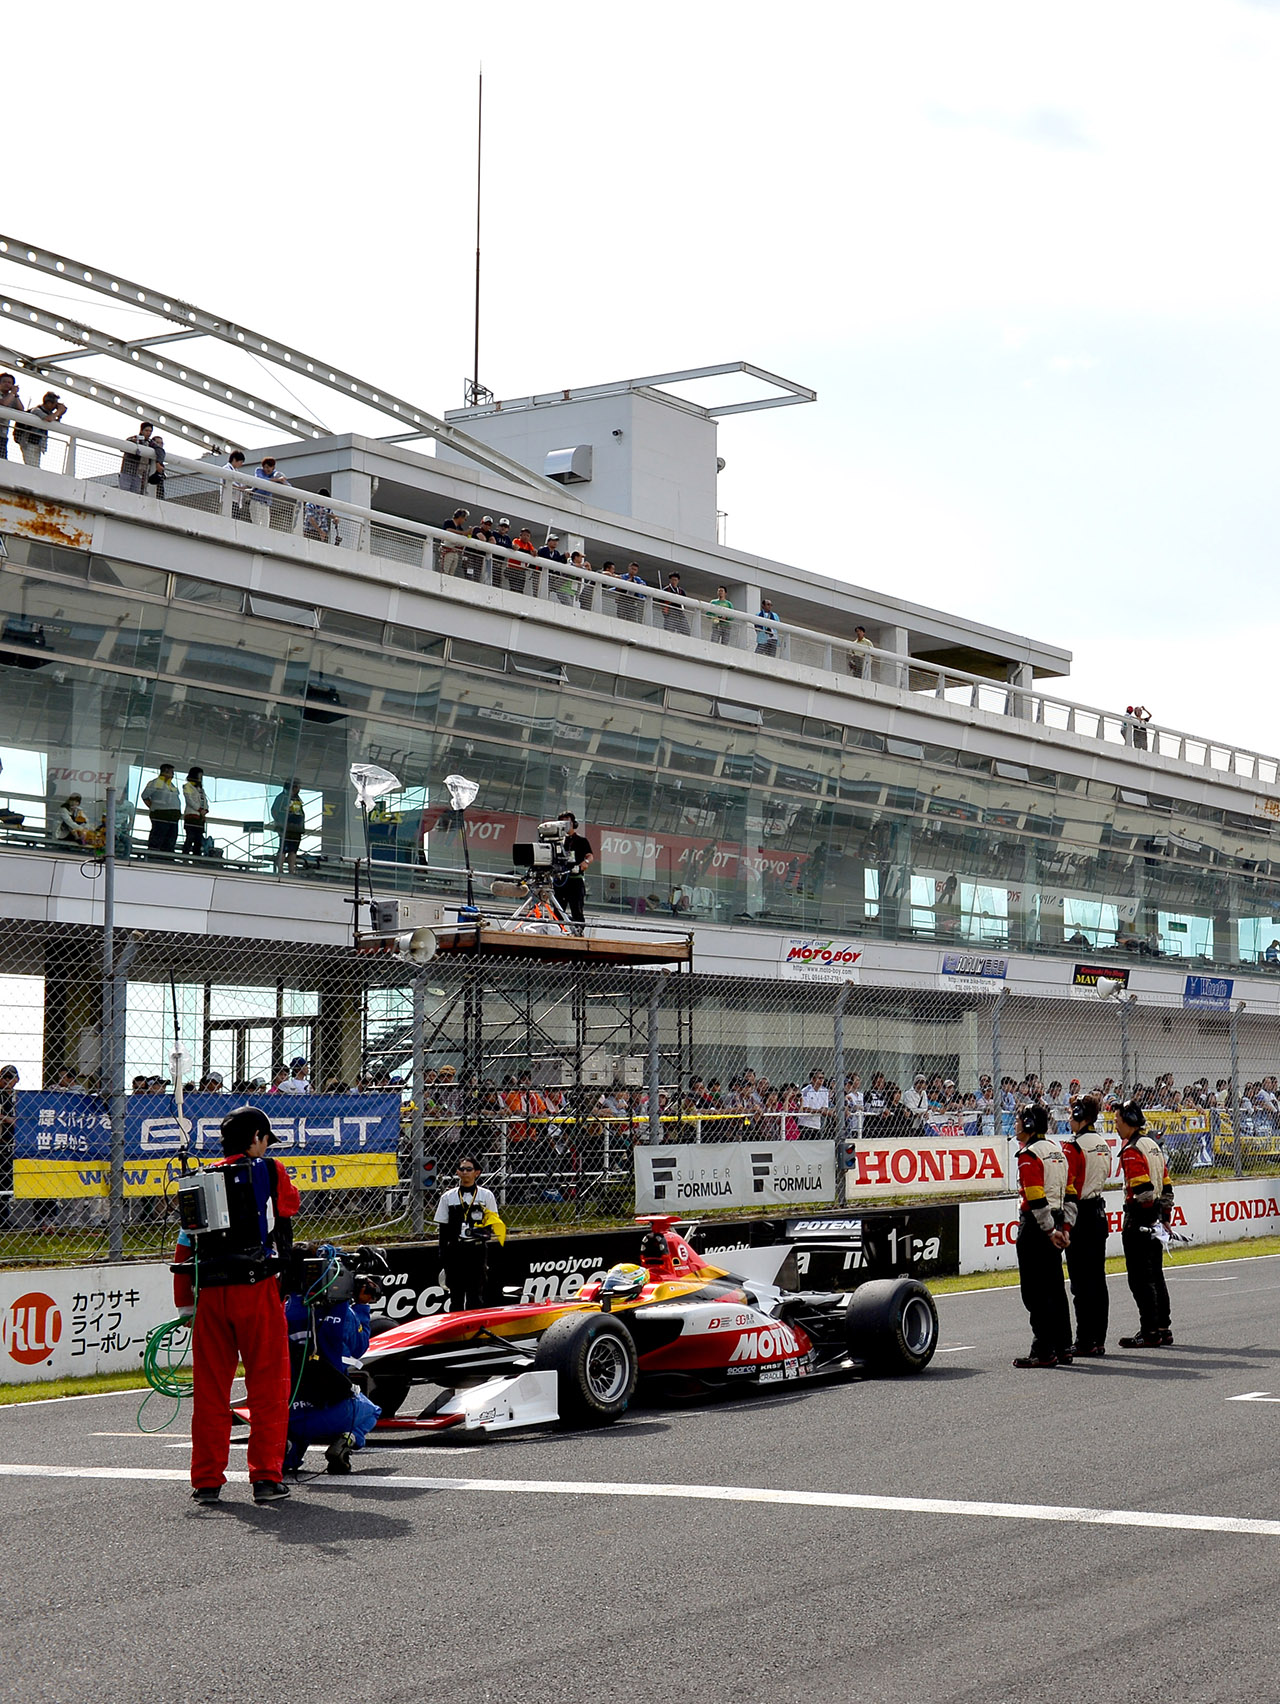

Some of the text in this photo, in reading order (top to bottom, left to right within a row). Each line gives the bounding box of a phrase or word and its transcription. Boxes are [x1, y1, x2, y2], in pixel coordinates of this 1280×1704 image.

[788, 947, 862, 963] MOTO BOY
[677, 1168, 731, 1181] SUPER
[773, 1164, 822, 1176] SUPER
[855, 1148, 1004, 1185] HONDA
[677, 1181, 733, 1198] FORMULA
[773, 1176, 822, 1192] FORMULA
[1210, 1198, 1280, 1223] HONDA
[794, 1220, 862, 1231] POTENZ
[529, 1256, 603, 1276] woojyon
[72, 1289, 140, 1312] カワサキ
[72, 1312, 122, 1334] ライフ
[728, 1327, 800, 1362] MOTUL
